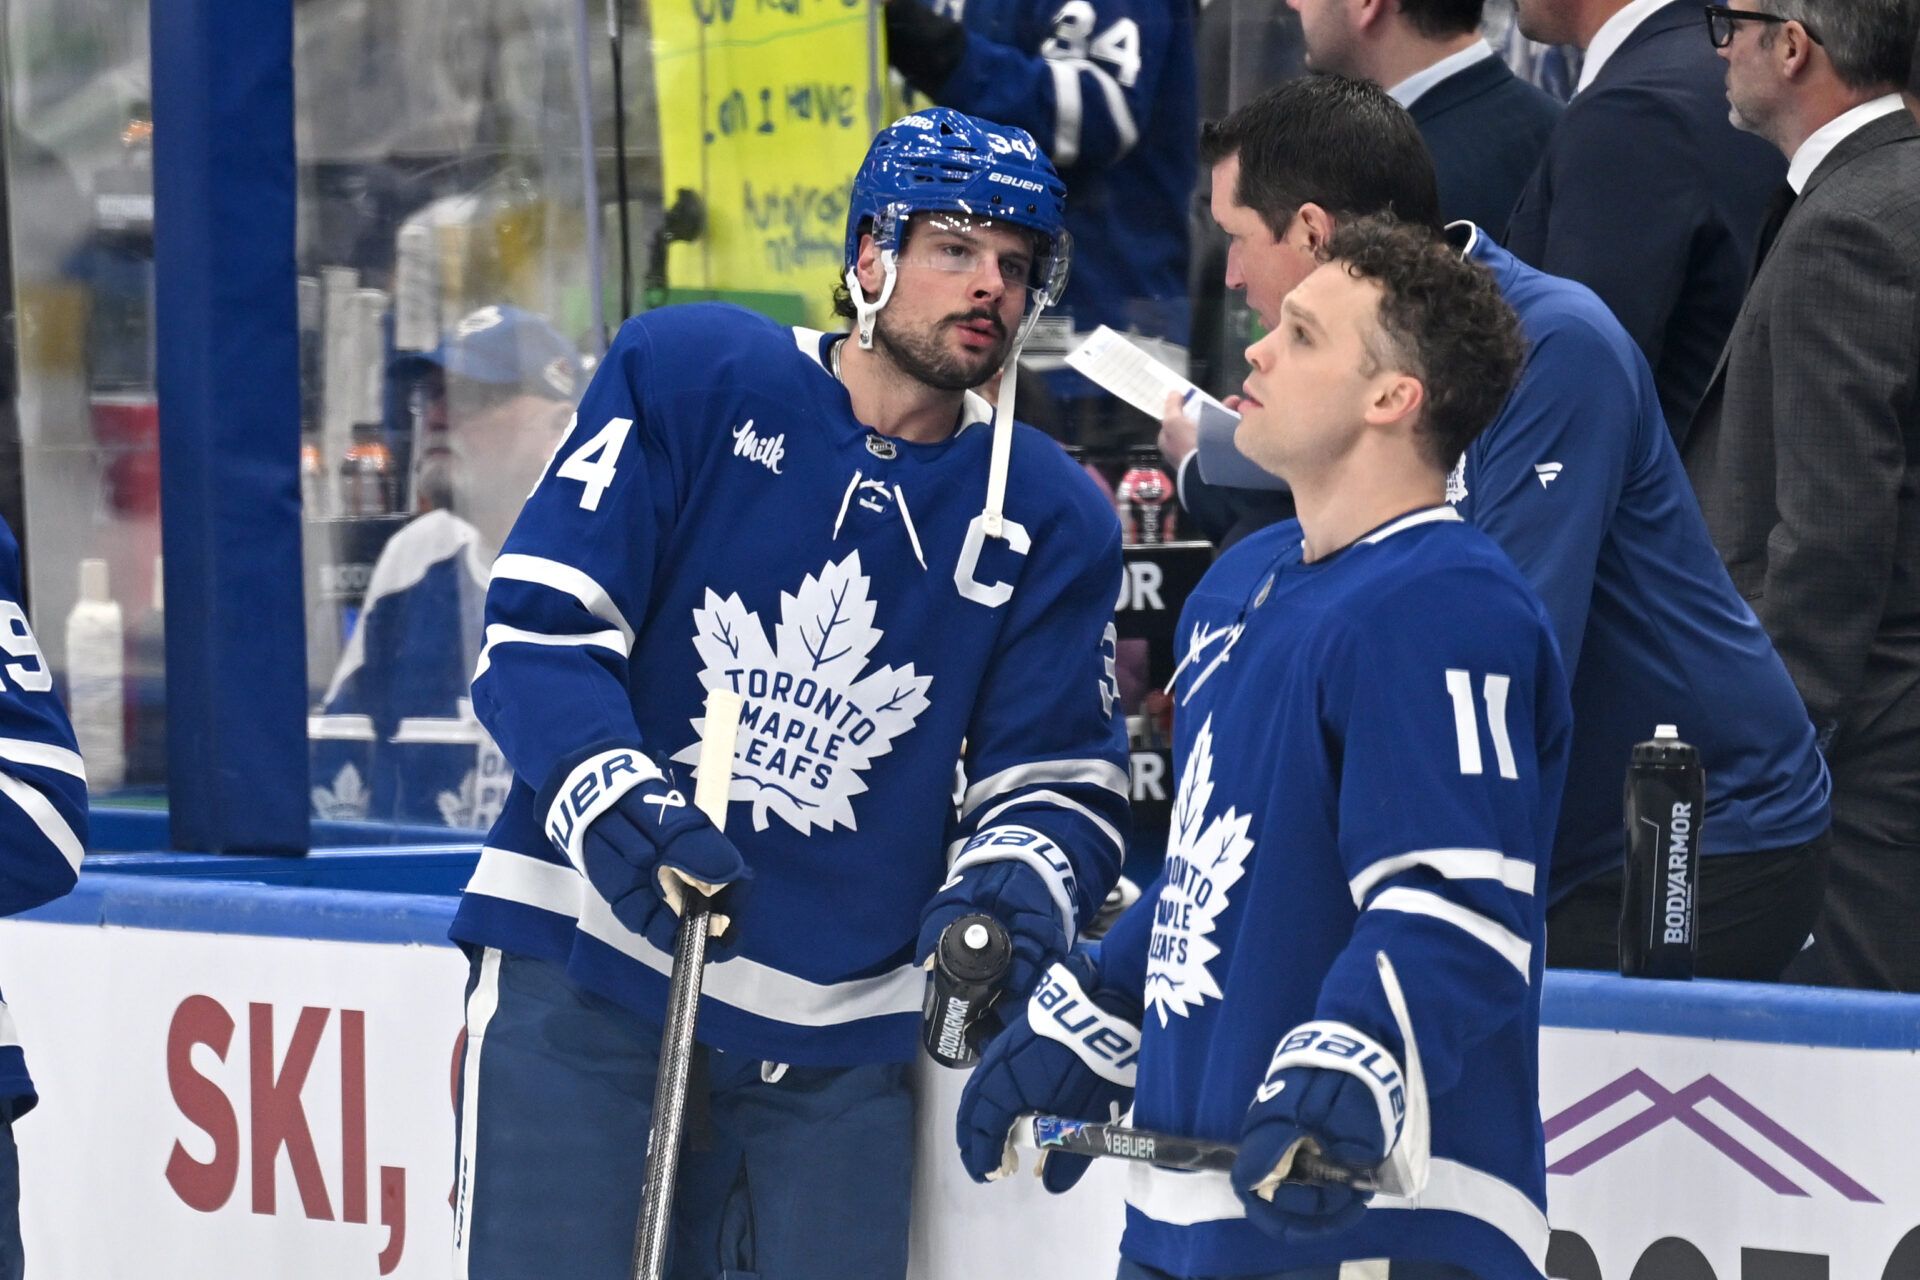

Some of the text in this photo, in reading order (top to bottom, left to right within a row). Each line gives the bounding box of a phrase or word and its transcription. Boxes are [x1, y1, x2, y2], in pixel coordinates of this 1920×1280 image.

[1041, 0, 1141, 88] 34
[988, 133, 1036, 161] 34
[527, 412, 633, 512] 4
[733, 418, 785, 475] Milk
[954, 510, 1031, 608] C
[0, 600, 53, 692] 9
[725, 668, 876, 746] TORONTO
[739, 700, 845, 761] MAPLE
[1445, 668, 1520, 780] 11
[733, 738, 833, 790] EAFS
[963, 830, 1080, 923] BAUE
[1664, 802, 1692, 944] BODYARMOR
[937, 996, 970, 1059] BODYARMOR
[1276, 1030, 1406, 1136] BAUE
[165, 994, 406, 1276] SKI,
